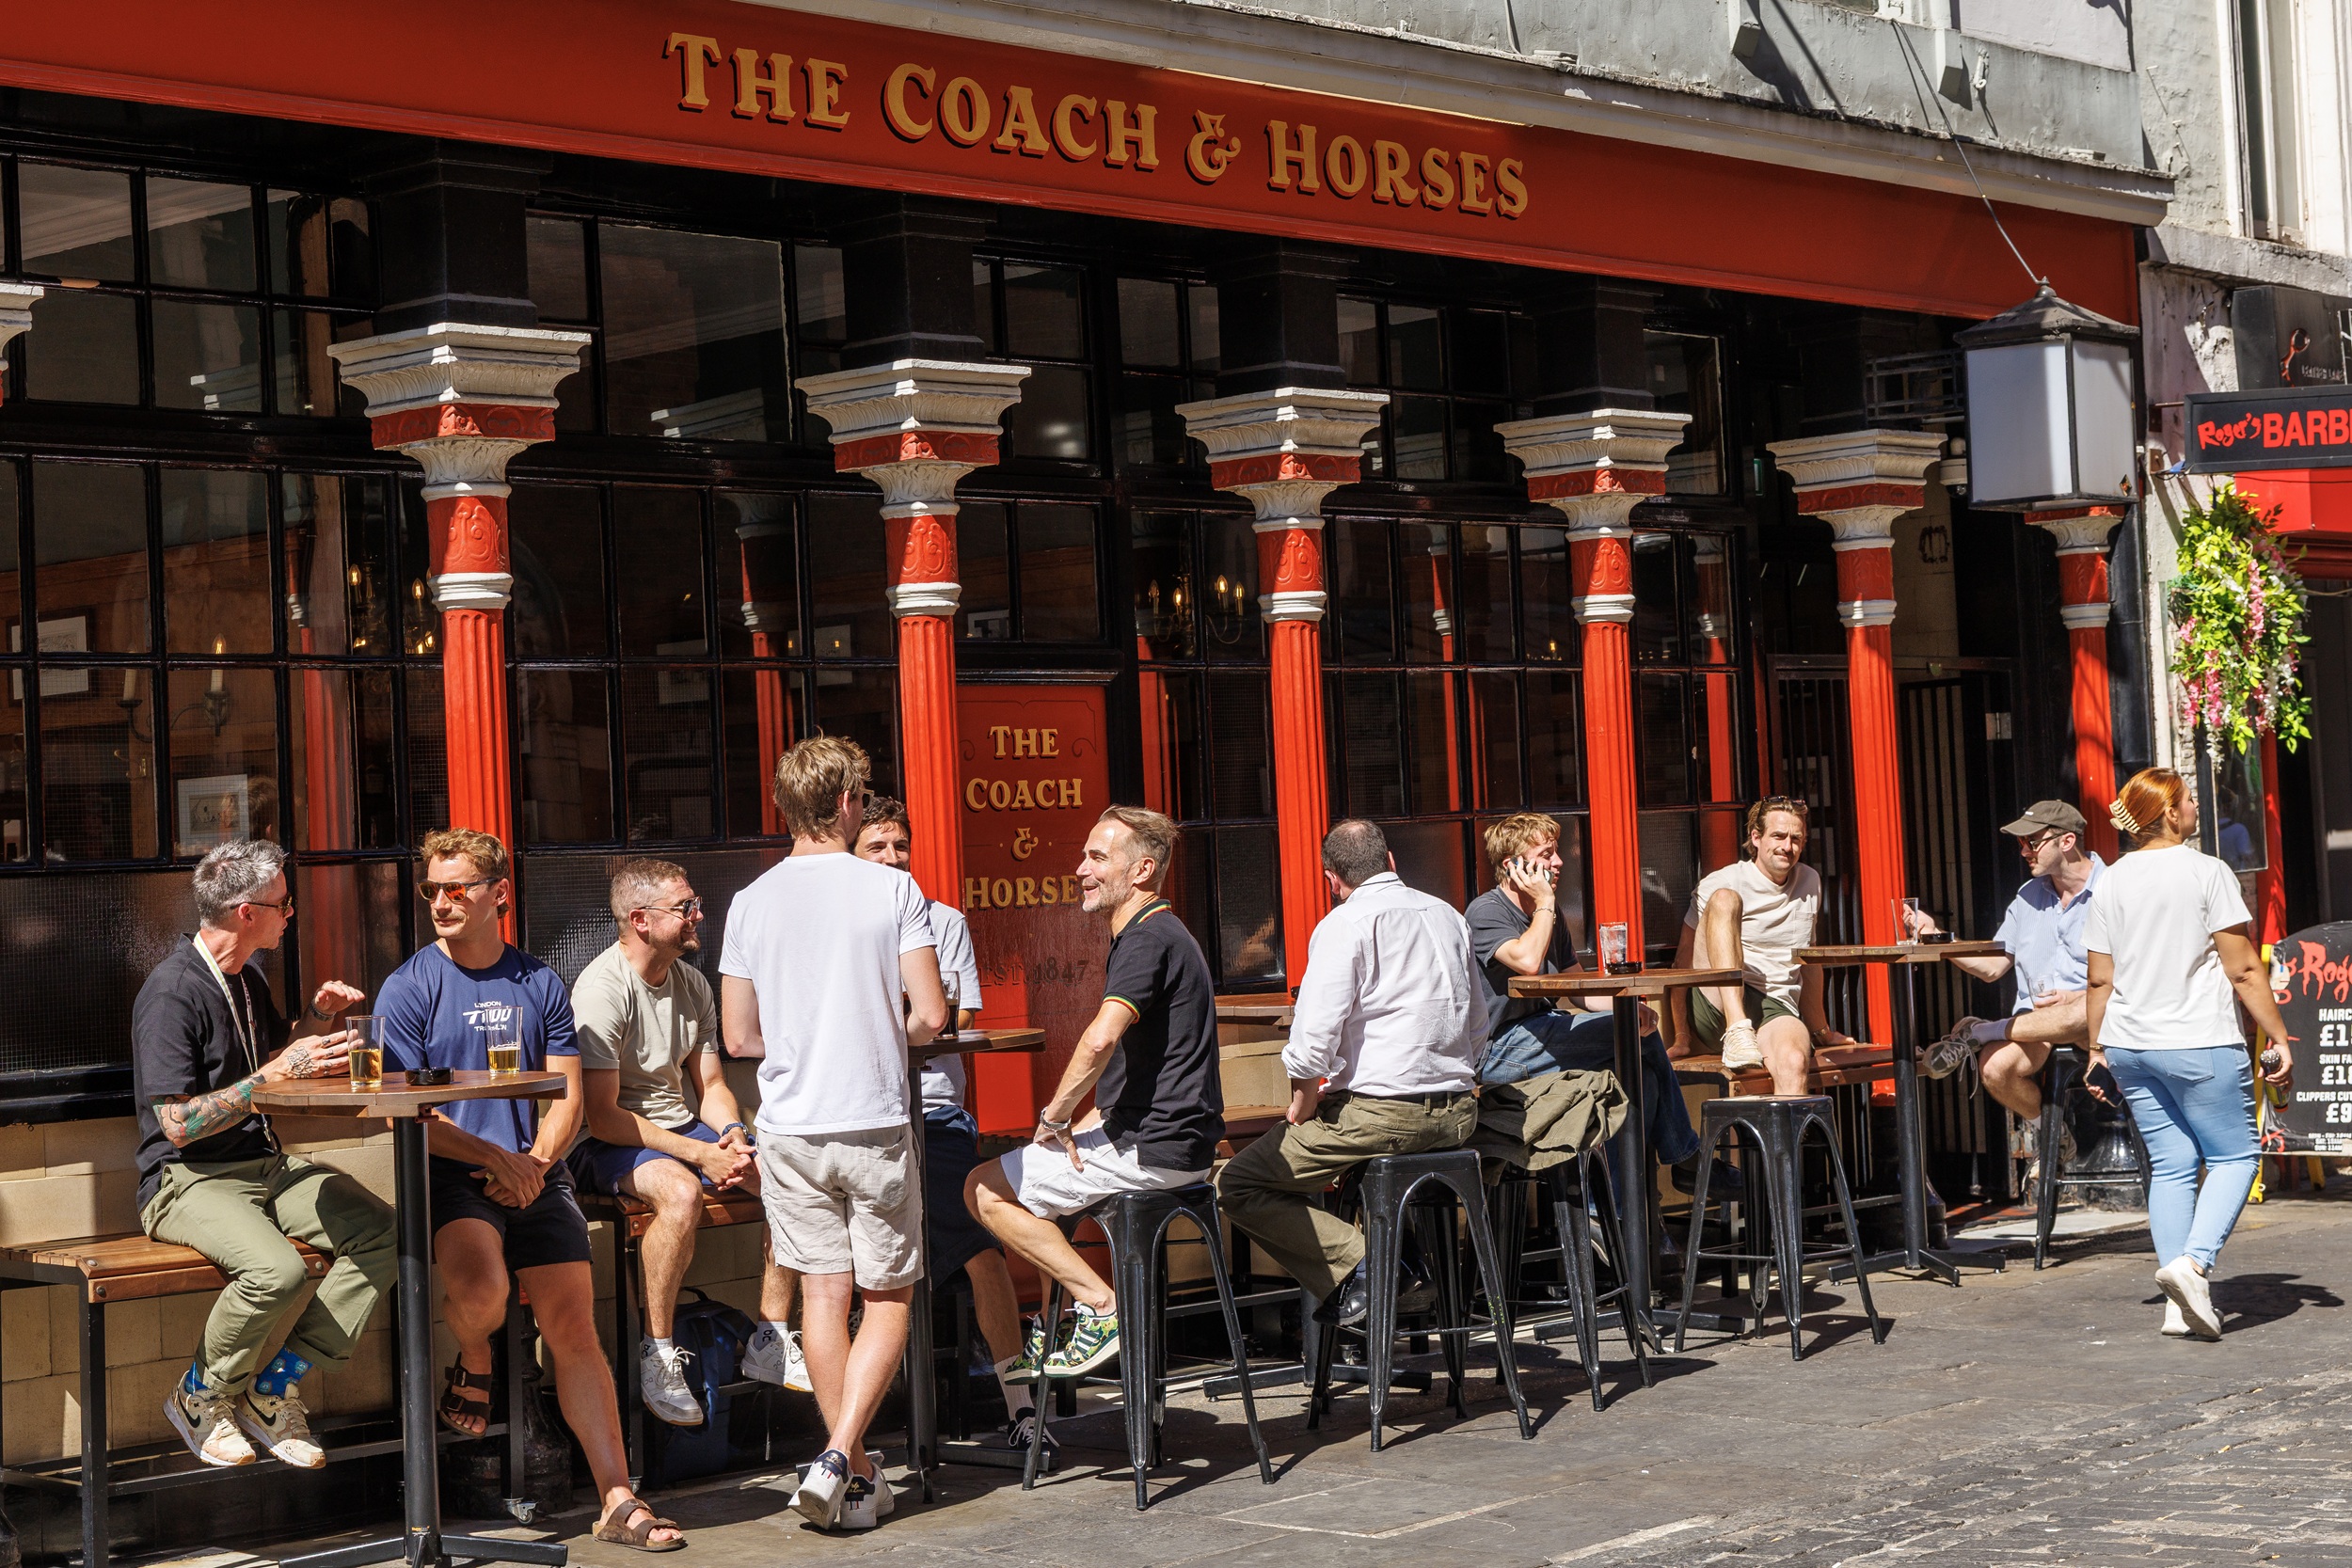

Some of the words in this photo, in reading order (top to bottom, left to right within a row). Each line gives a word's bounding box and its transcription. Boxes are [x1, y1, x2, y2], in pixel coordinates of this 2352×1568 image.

[662, 32, 851, 132] THE
[882, 62, 1161, 171] COACH
[1184, 109, 1241, 184] &
[1263, 119, 1529, 219] HORSES
[2197, 412, 2262, 451] Roger's
[2263, 409, 2352, 449] BARB
[988, 725, 1059, 759] THE
[965, 777, 1083, 812] COACH
[1011, 827, 1039, 861] &
[965, 874, 1084, 911] HORSE
[2319, 1023, 2352, 1047] £1
[2318, 1053, 2341, 1065] SKIN
[2296, 1091, 2336, 1102] CLIPPERS
[2326, 1102, 2352, 1124] £9
